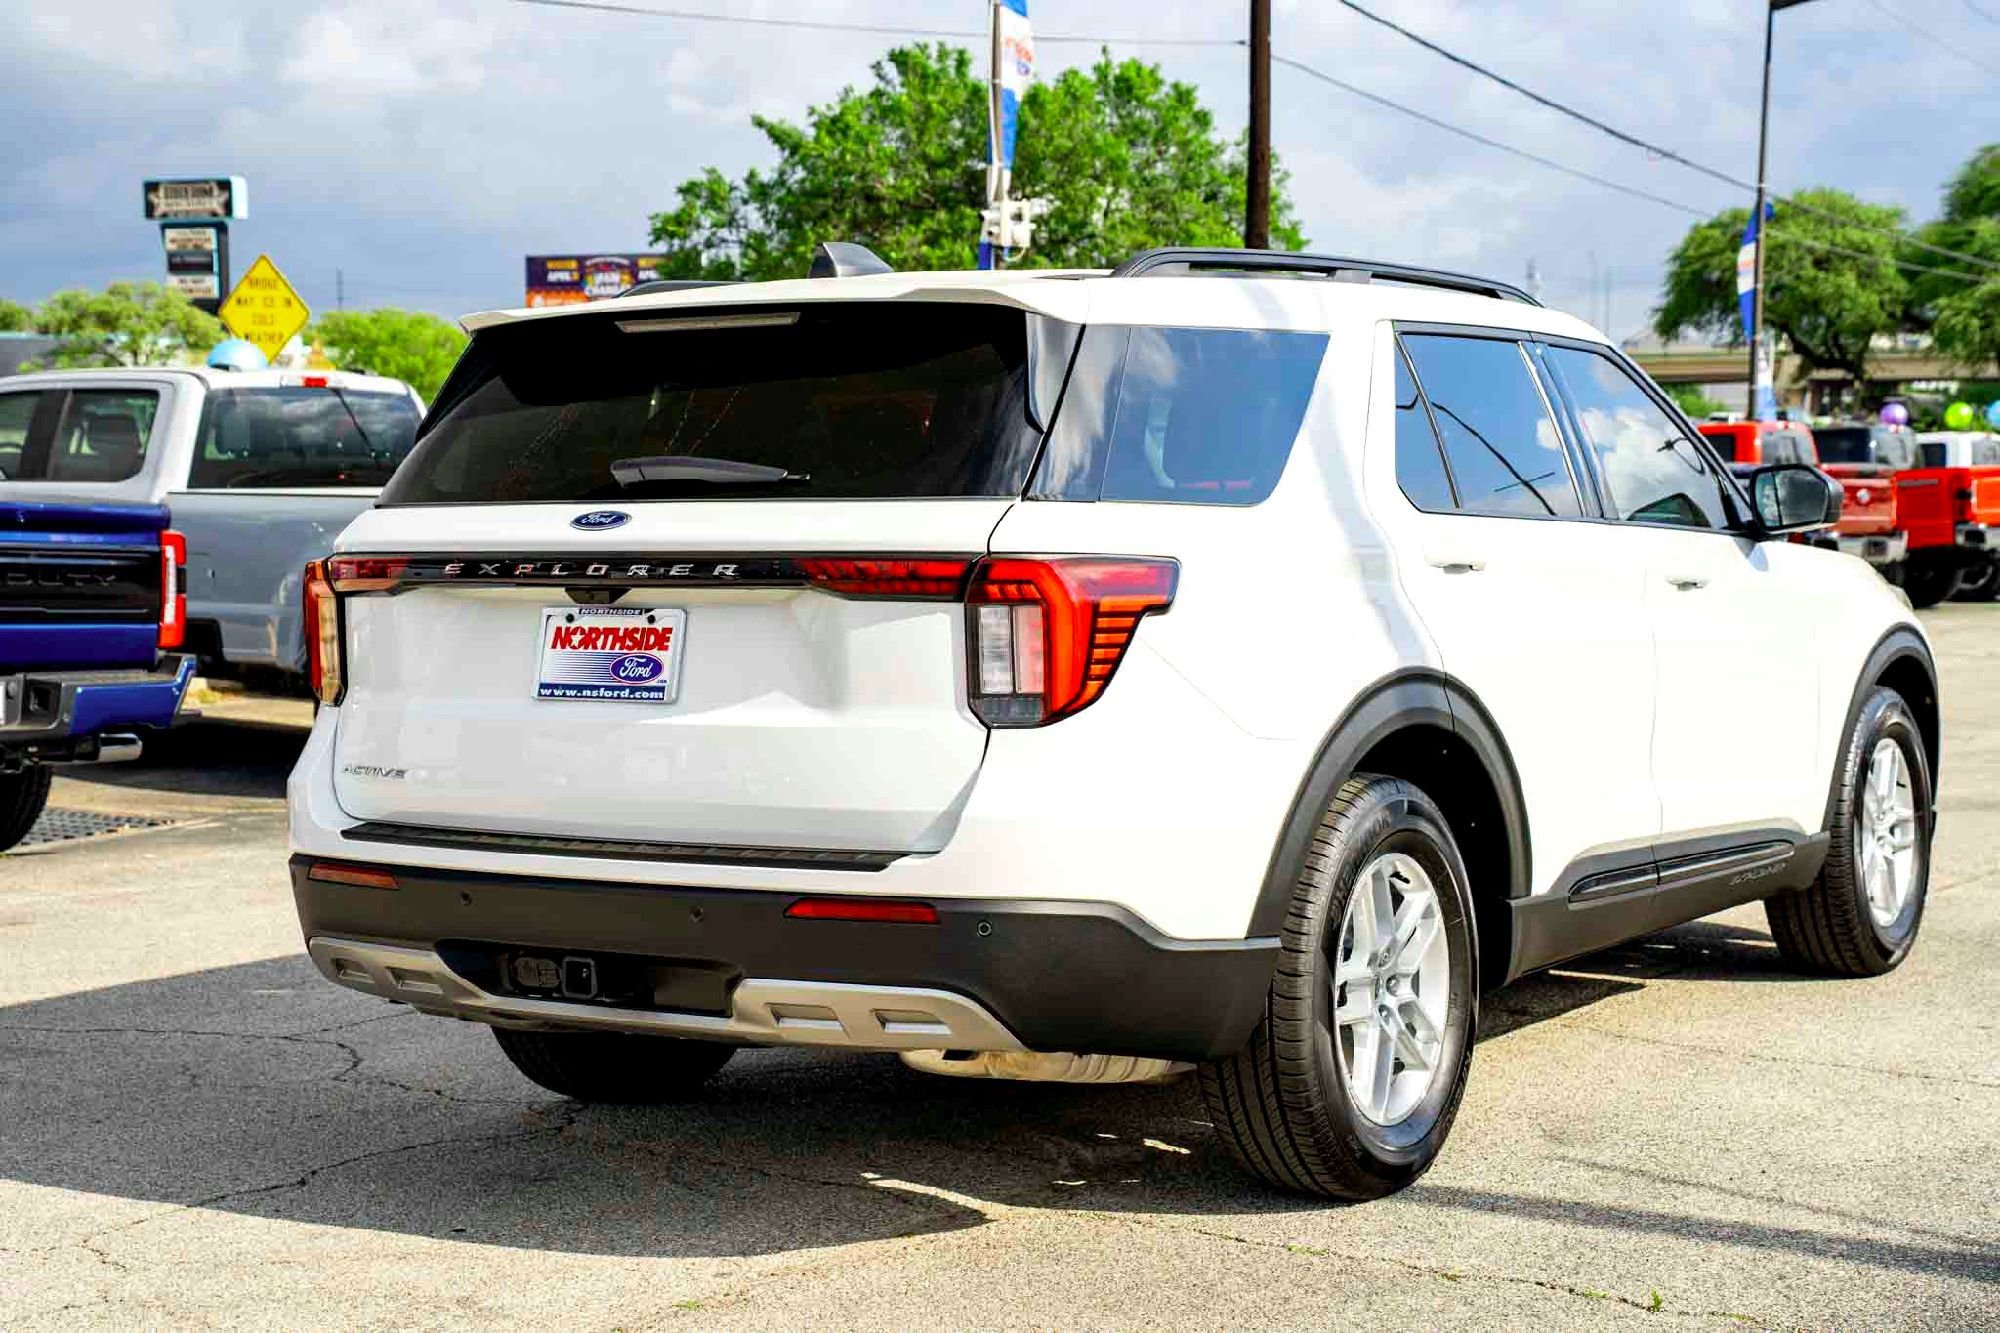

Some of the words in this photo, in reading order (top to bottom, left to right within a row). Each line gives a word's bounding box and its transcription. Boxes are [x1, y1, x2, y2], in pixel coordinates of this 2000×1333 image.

[580, 512, 617, 524] Ford
[444, 562, 739, 577] EXPLORER
[580, 608, 642, 616] NORTHSIDE
[551, 625, 674, 652] NORTHSIDE
[618, 656, 655, 679] Ford
[539, 687, 664, 699] www.nsford.com
